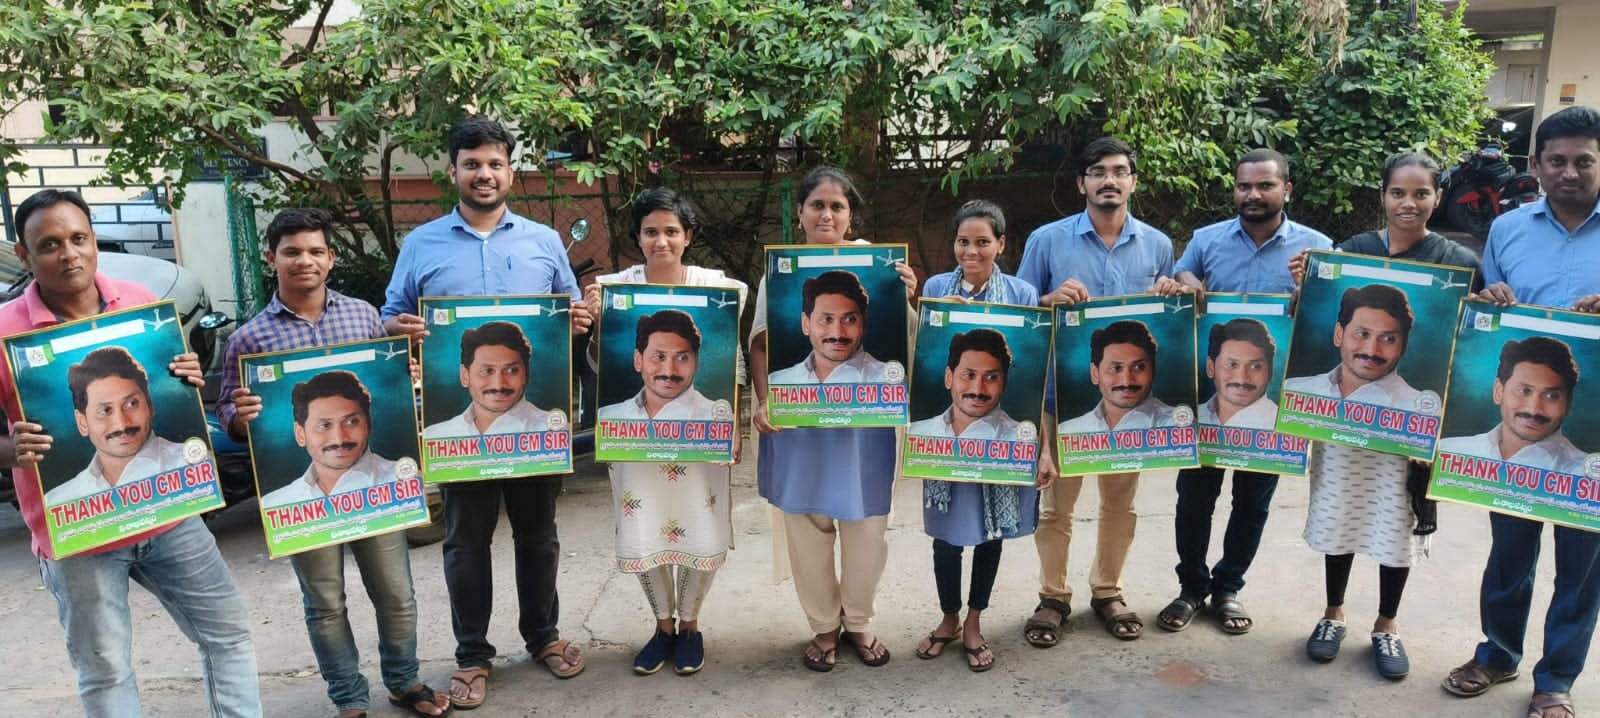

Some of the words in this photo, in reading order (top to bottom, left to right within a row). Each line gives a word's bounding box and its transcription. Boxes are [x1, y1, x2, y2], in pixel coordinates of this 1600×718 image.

[770, 386, 819, 404] THANK
[823, 386, 852, 404] YOU
[857, 385, 877, 404] CM
[881, 385, 906, 403] SIR
[1284, 392, 1339, 418] THANK
[1344, 402, 1377, 424] YOU
[1379, 409, 1404, 430] CM
[1407, 415, 1438, 436] SIR
[599, 421, 648, 439] THANK
[653, 422, 680, 439] YOU
[684, 422, 705, 439] CM
[709, 423, 732, 440] SIR
[1061, 434, 1111, 452] THANK
[1113, 431, 1142, 448] YOU
[1146, 429, 1167, 447] CM
[1171, 427, 1195, 446] SIR
[1223, 428, 1252, 447] YOU
[1256, 431, 1277, 449] CM
[1282, 433, 1306, 452] SIR
[427, 438, 480, 457] THANK
[485, 436, 515, 454] YOU
[519, 433, 540, 451] CM
[544, 431, 568, 449] SIR
[908, 437, 954, 456] THANK
[958, 440, 986, 458] YOU
[989, 441, 1009, 460] CM
[1012, 443, 1036, 461] SIR
[1439, 453, 1500, 482] THANK
[1506, 463, 1541, 490] YOU
[1544, 472, 1573, 496] CM
[1576, 478, 1600, 502] SI
[51, 492, 114, 527] THANK
[119, 480, 153, 507] YOU
[157, 471, 181, 495] CM
[184, 463, 215, 487] SIR
[267, 499, 327, 529] THANK
[330, 490, 364, 514] YOU
[367, 485, 392, 506] CM
[395, 479, 421, 501] SIR
